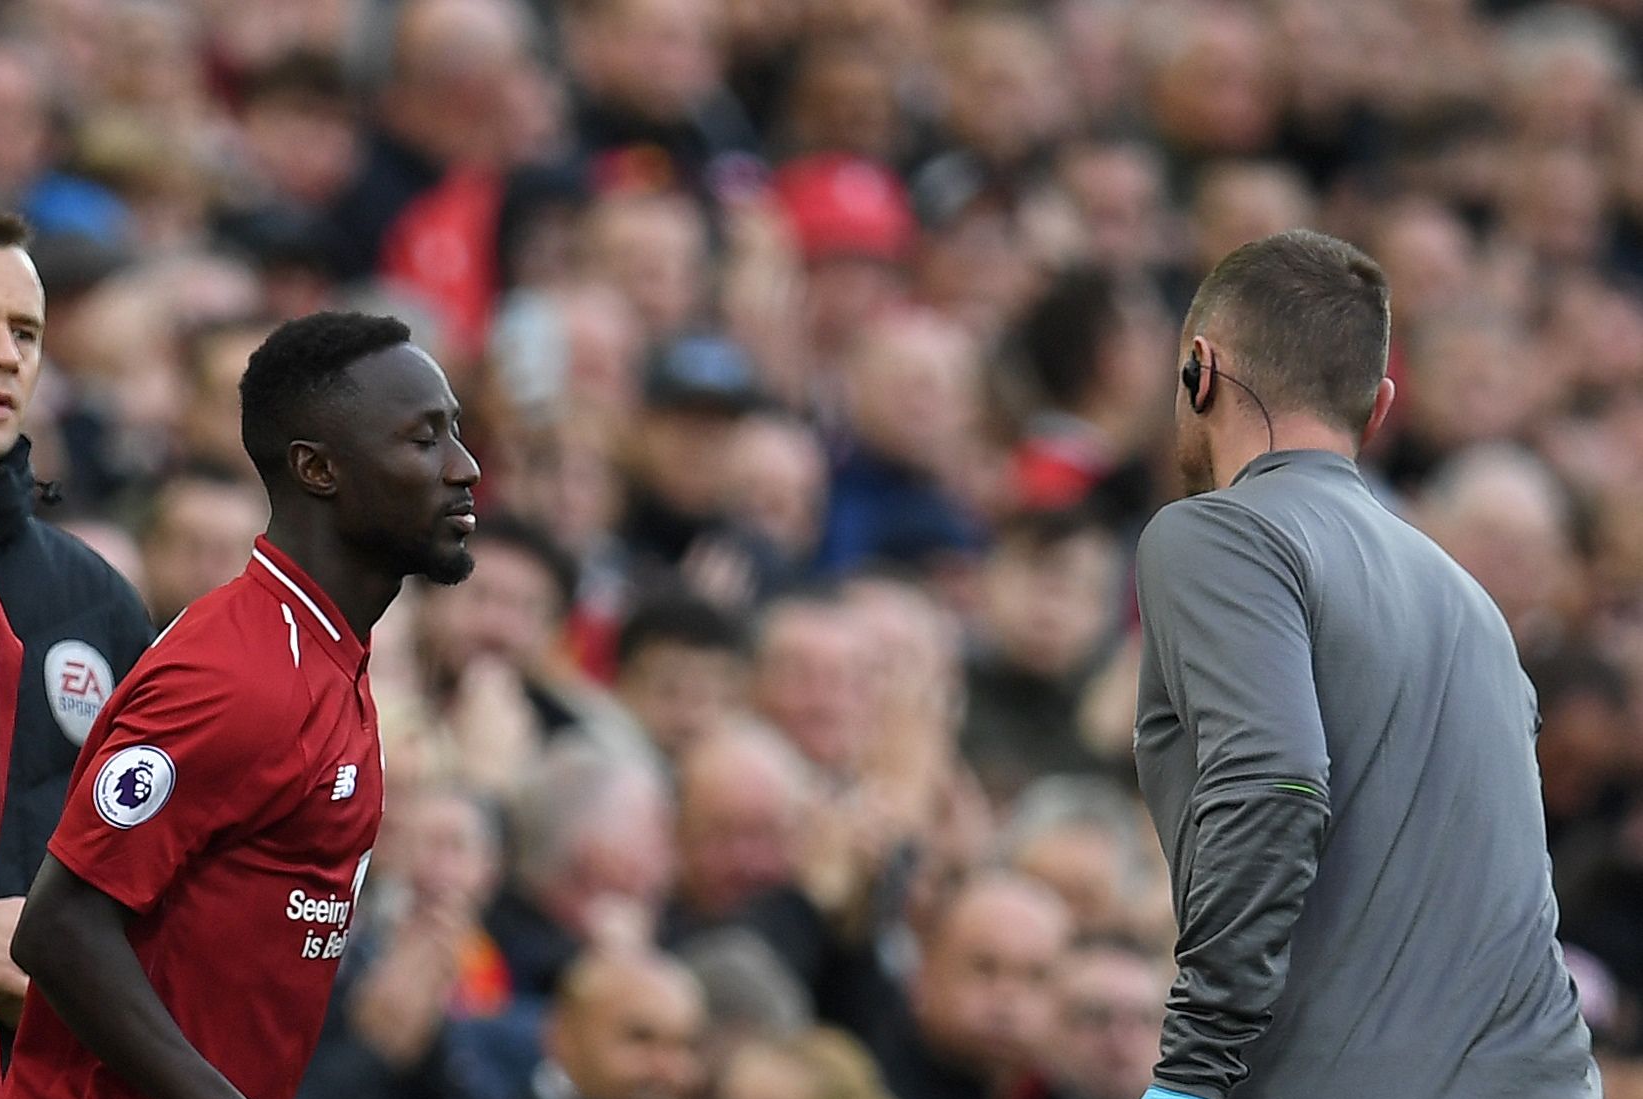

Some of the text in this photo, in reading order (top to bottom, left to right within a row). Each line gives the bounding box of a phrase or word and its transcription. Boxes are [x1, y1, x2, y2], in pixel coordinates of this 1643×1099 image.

[62, 661, 104, 700] EA
[286, 889, 351, 929] Seeing
[301, 929, 323, 958] is
